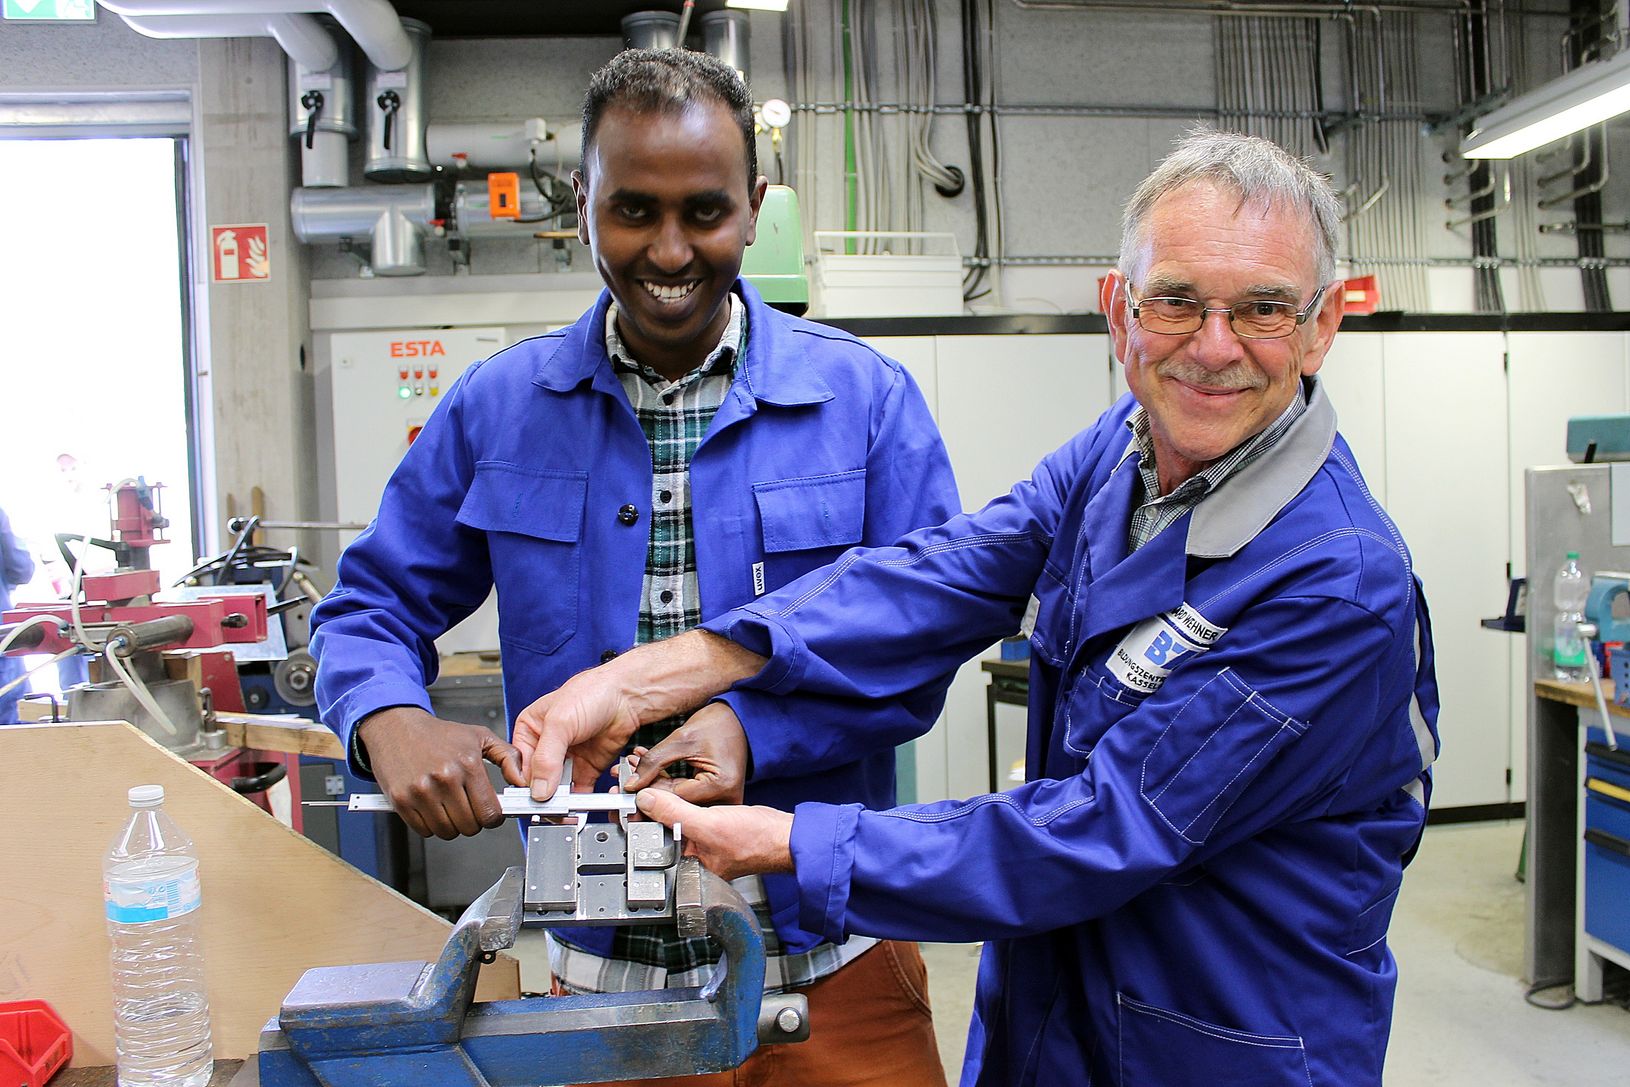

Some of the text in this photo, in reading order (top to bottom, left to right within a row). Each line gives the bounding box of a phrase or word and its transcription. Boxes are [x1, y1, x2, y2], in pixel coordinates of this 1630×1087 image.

[390, 341, 446, 358] ESTA
[1182, 614, 1218, 641] WEHNER
[1126, 671, 1158, 690] KASSEL
